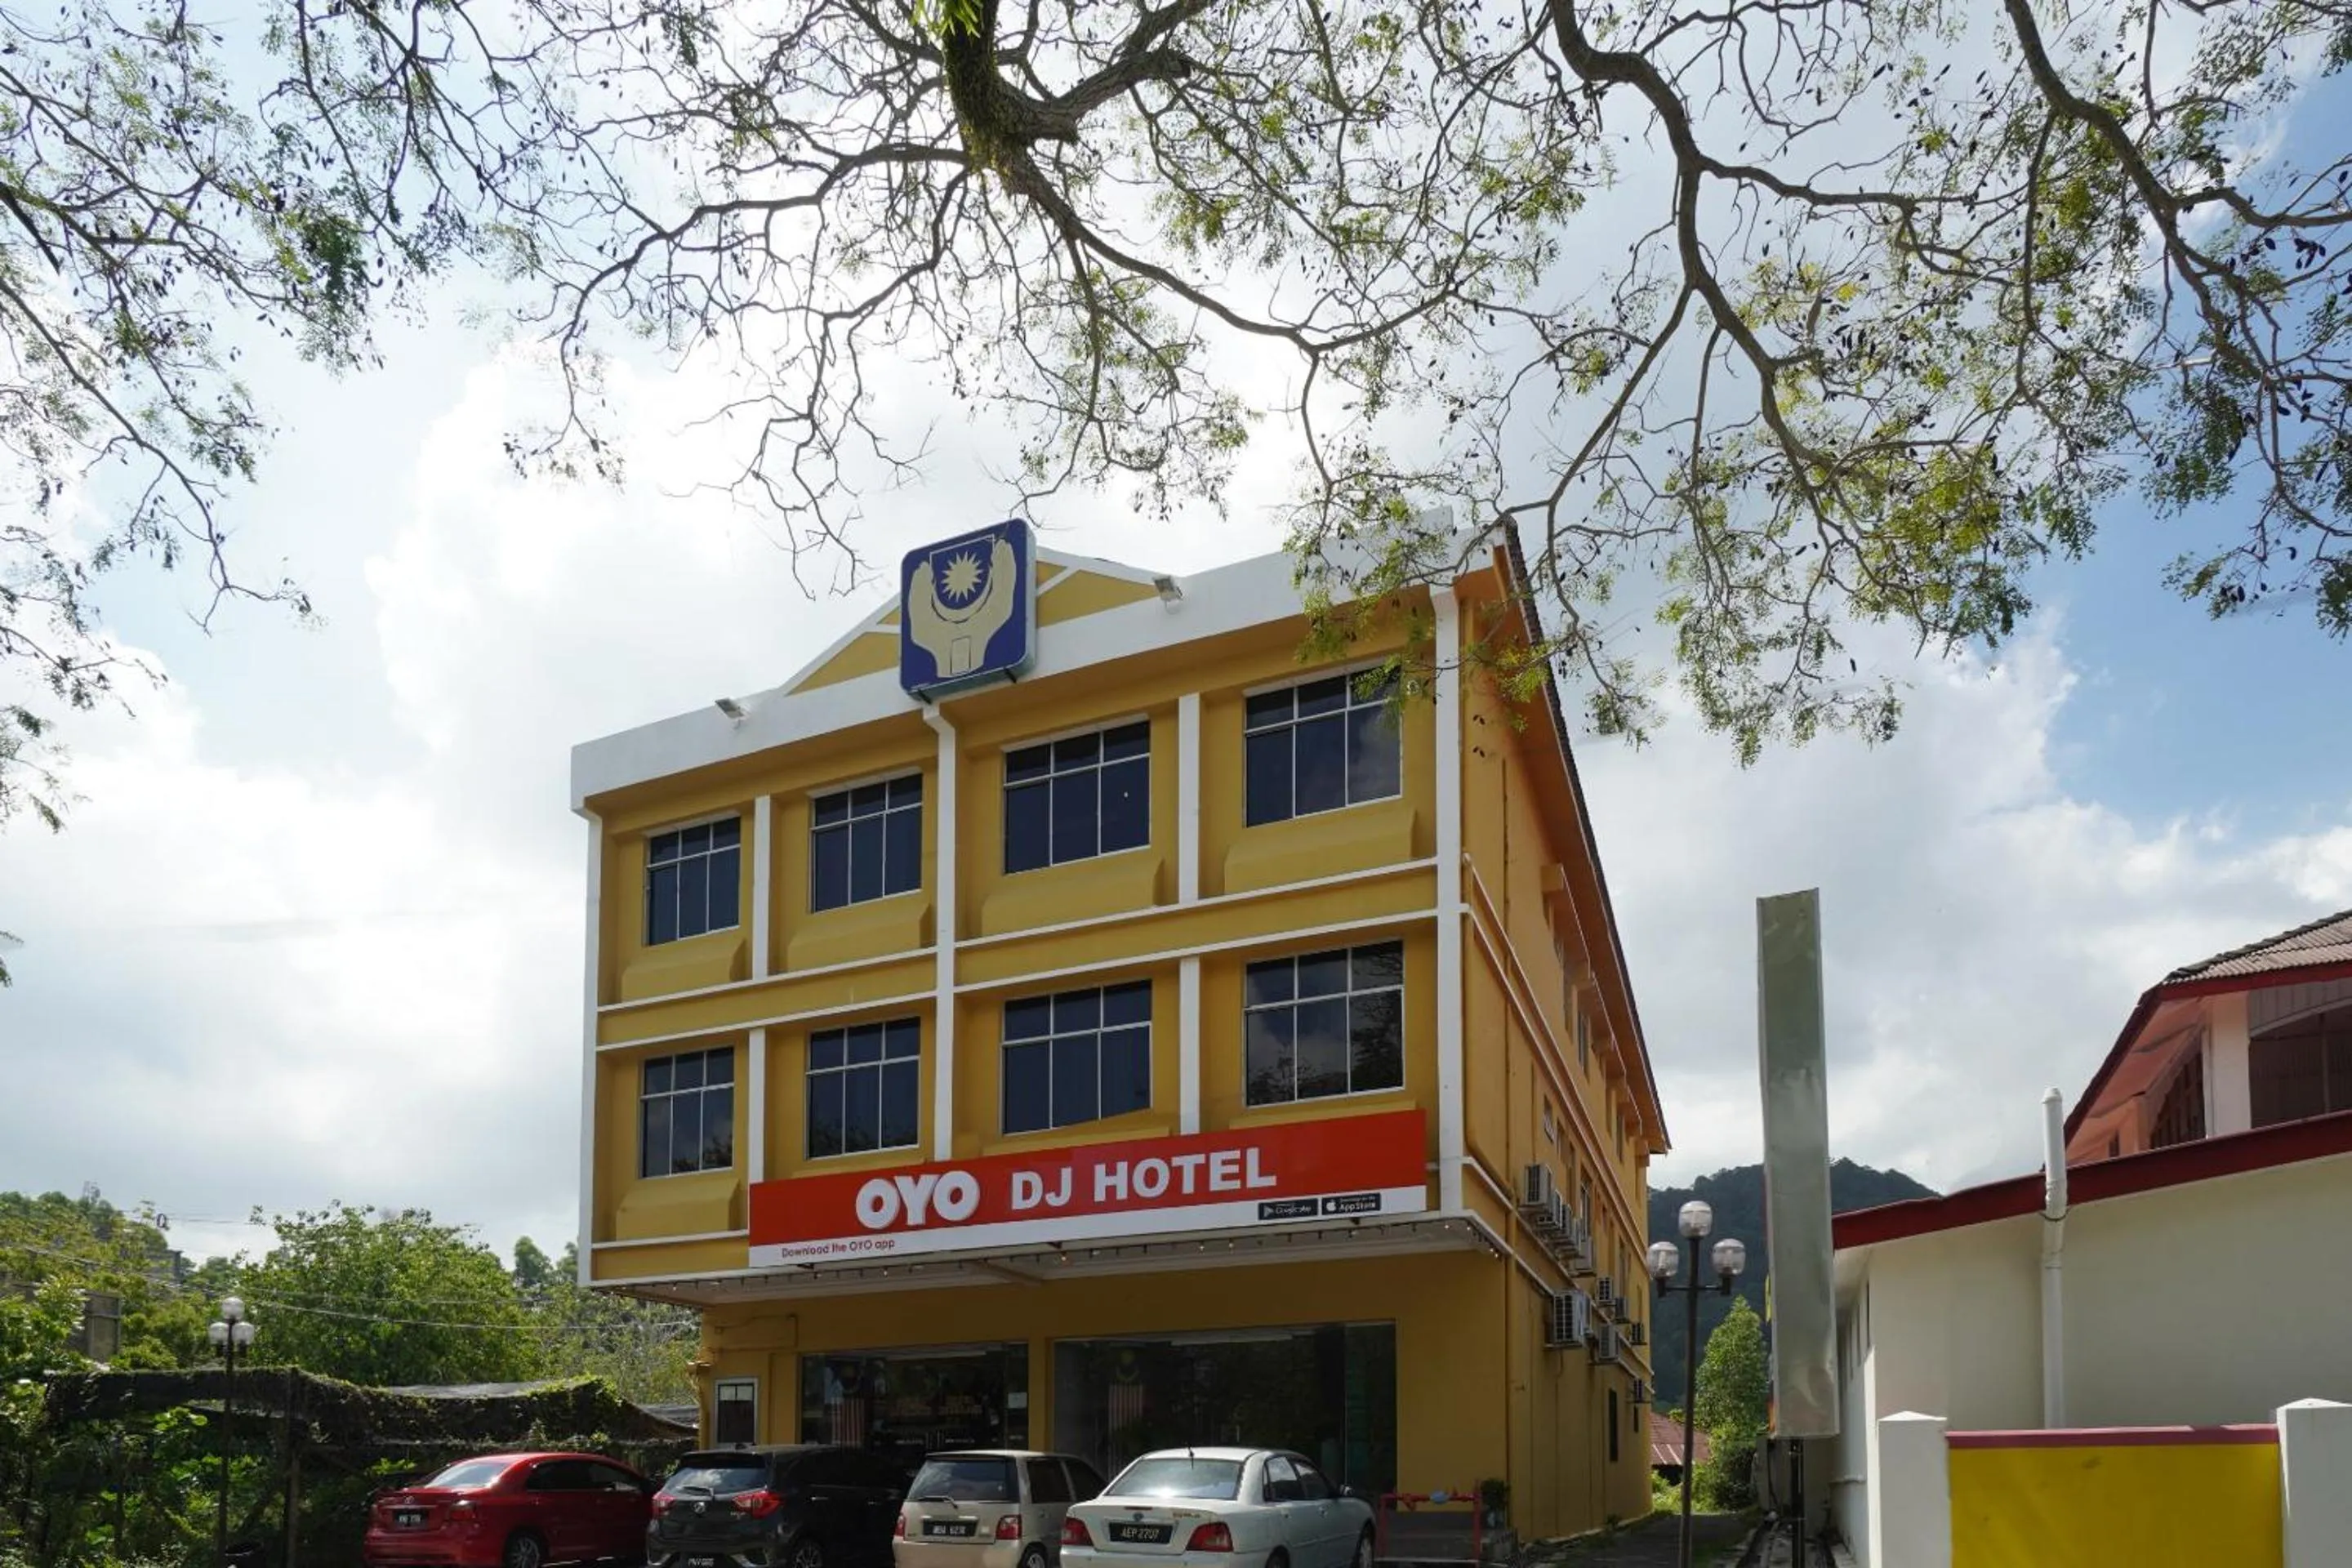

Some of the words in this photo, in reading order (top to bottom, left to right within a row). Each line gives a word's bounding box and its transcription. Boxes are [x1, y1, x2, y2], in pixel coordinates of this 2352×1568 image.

[855, 1170, 980, 1229] OYO
[1011, 1167, 1072, 1209] DJ
[1093, 1147, 1277, 1202] HOTEL
[782, 1244, 829, 1258] Download
[831, 1242, 847, 1253] the
[849, 1240, 872, 1251] OYO
[875, 1239, 896, 1250] app
